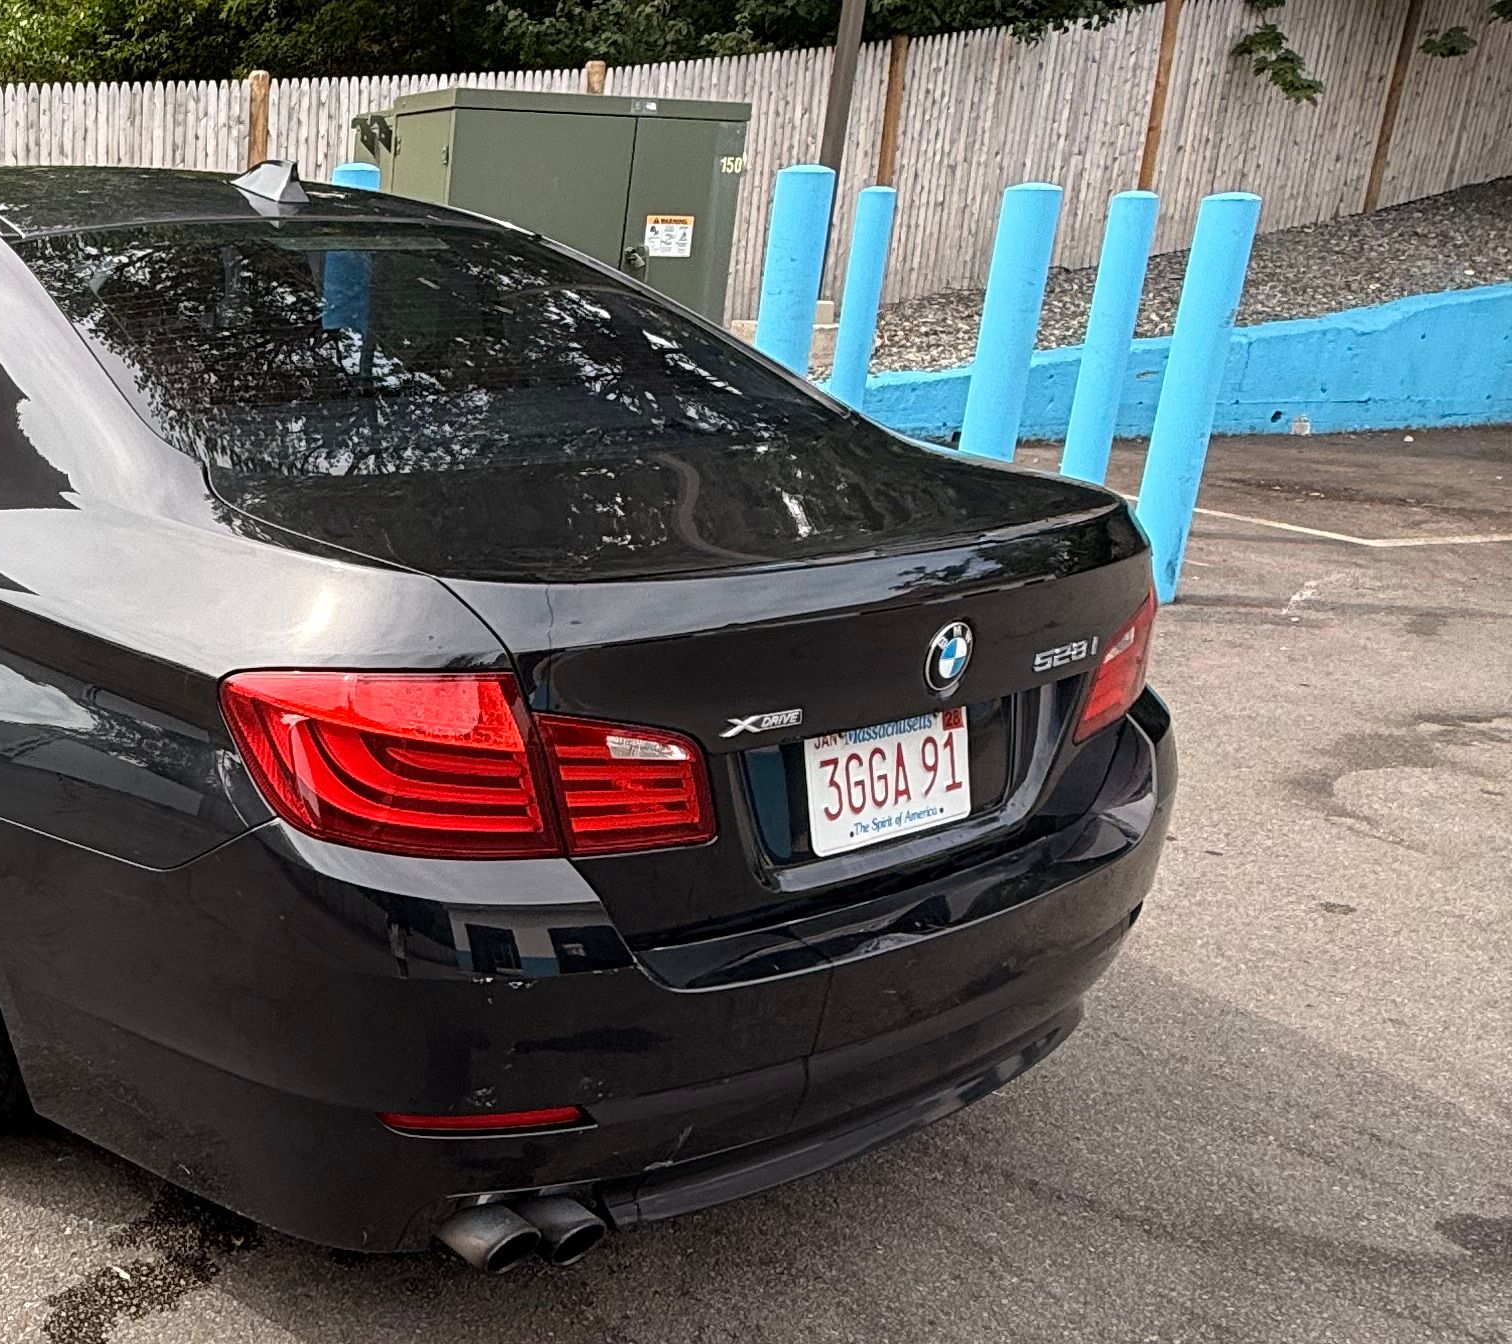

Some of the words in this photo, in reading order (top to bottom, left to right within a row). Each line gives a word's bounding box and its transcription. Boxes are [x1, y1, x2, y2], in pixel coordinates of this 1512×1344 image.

[814, 734, 838, 749] JAN
[819, 742, 912, 822] 3GGA
[921, 731, 963, 799] 91
[854, 822, 870, 835] The
[871, 816, 893, 832] Spirit
[894, 811, 904, 827] of
[904, 806, 938, 824] America
